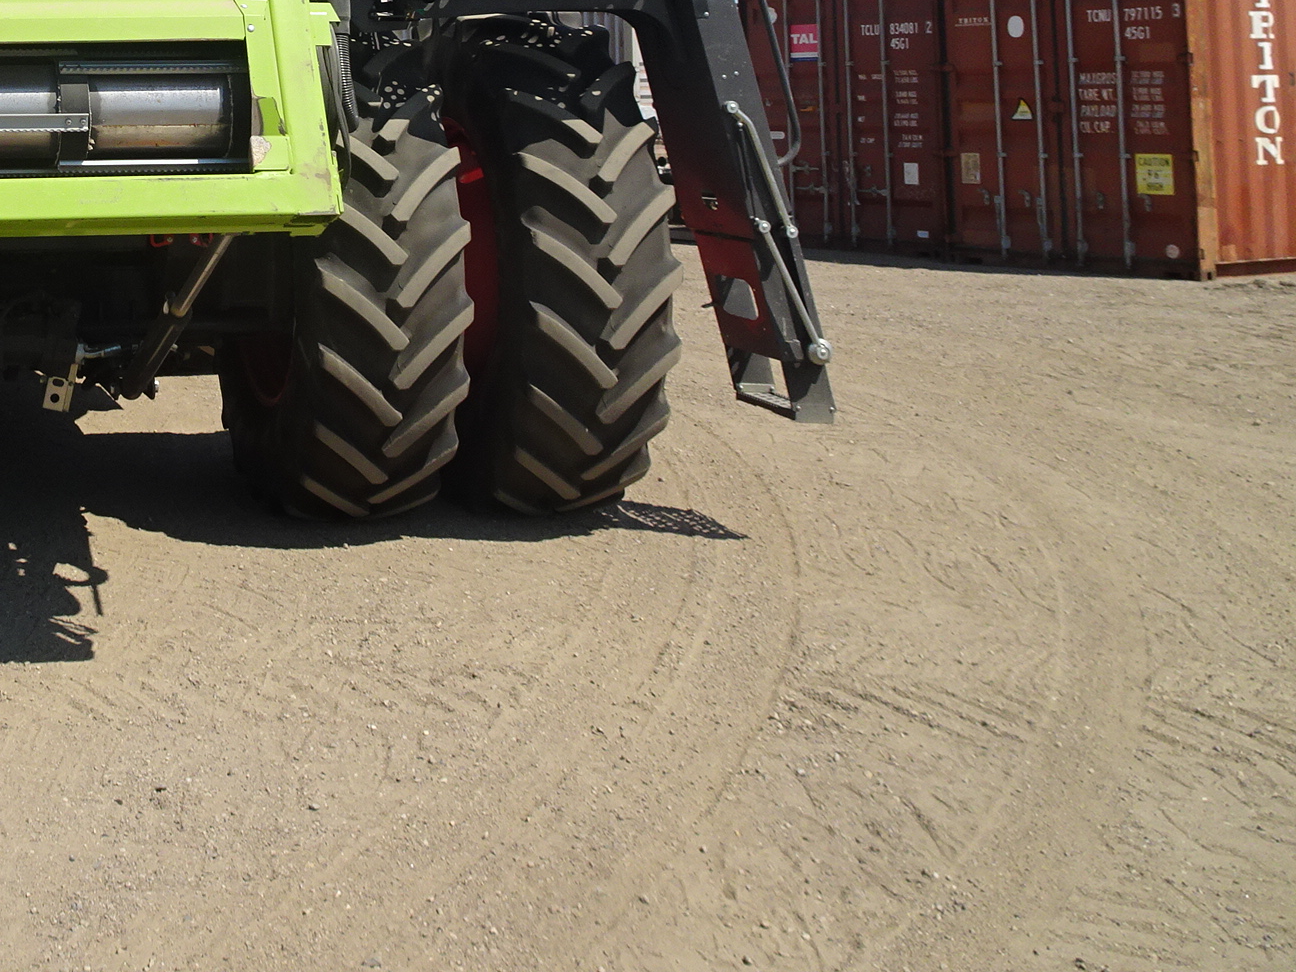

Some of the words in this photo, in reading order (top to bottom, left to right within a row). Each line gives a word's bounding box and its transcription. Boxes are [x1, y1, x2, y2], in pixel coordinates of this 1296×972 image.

[1123, 6, 1163, 22] 797115
[1171, 2, 1181, 18] 3
[860, 24, 881, 36] TCLU
[889, 22, 919, 35] 834081
[925, 21, 933, 34] 2
[1124, 26, 1151, 40] 45G1
[790, 33, 818, 45] TAL
